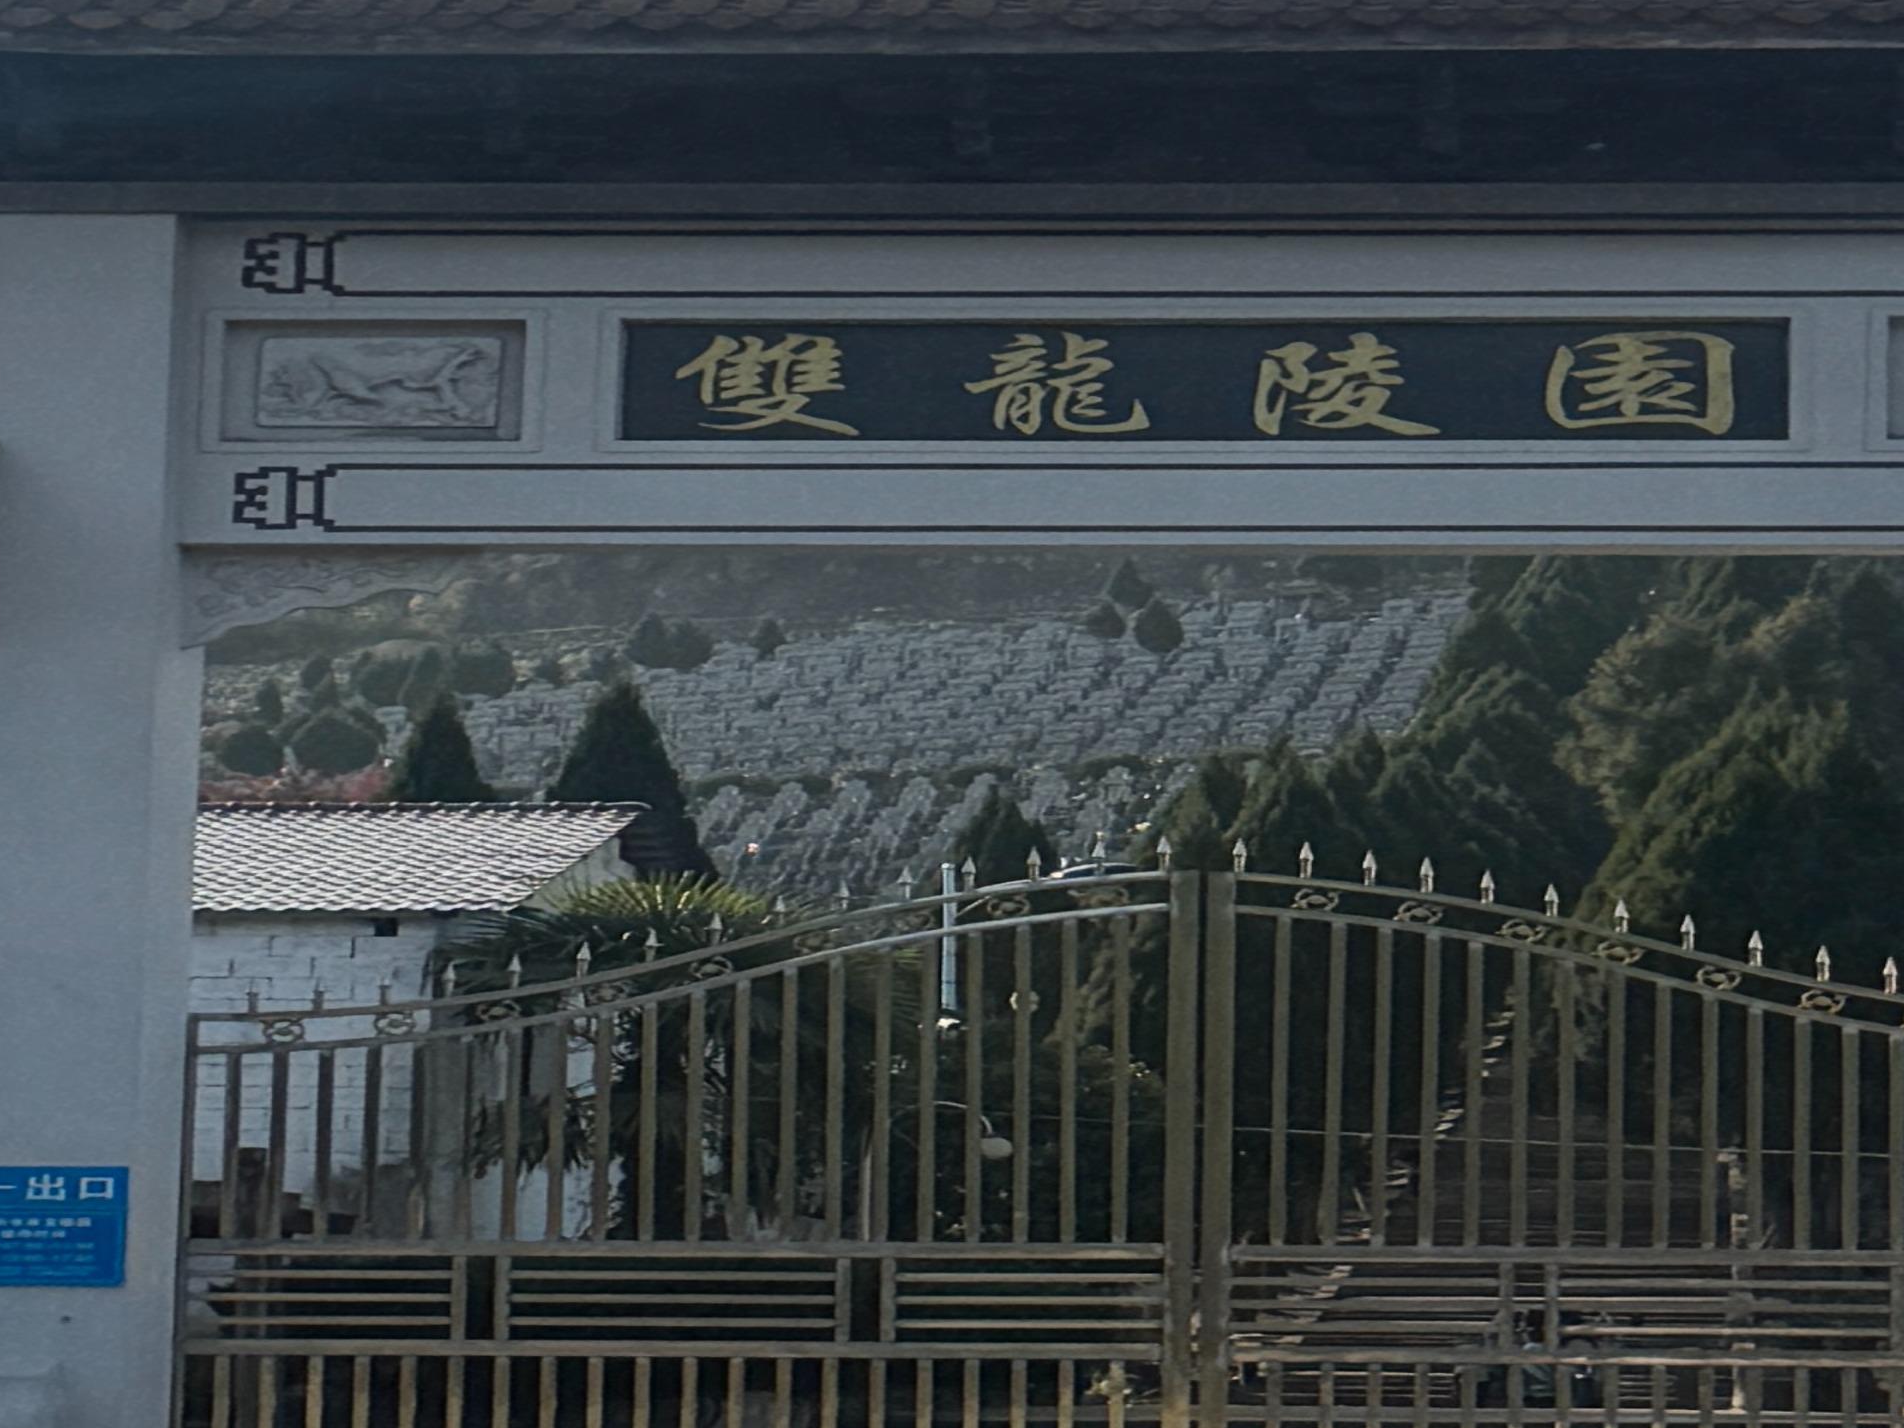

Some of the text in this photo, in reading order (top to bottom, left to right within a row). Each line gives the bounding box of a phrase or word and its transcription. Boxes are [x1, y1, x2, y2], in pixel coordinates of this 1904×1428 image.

[675, 330, 1735, 437] 雙龍陵園
[25, 1173, 115, 1201] 出口
